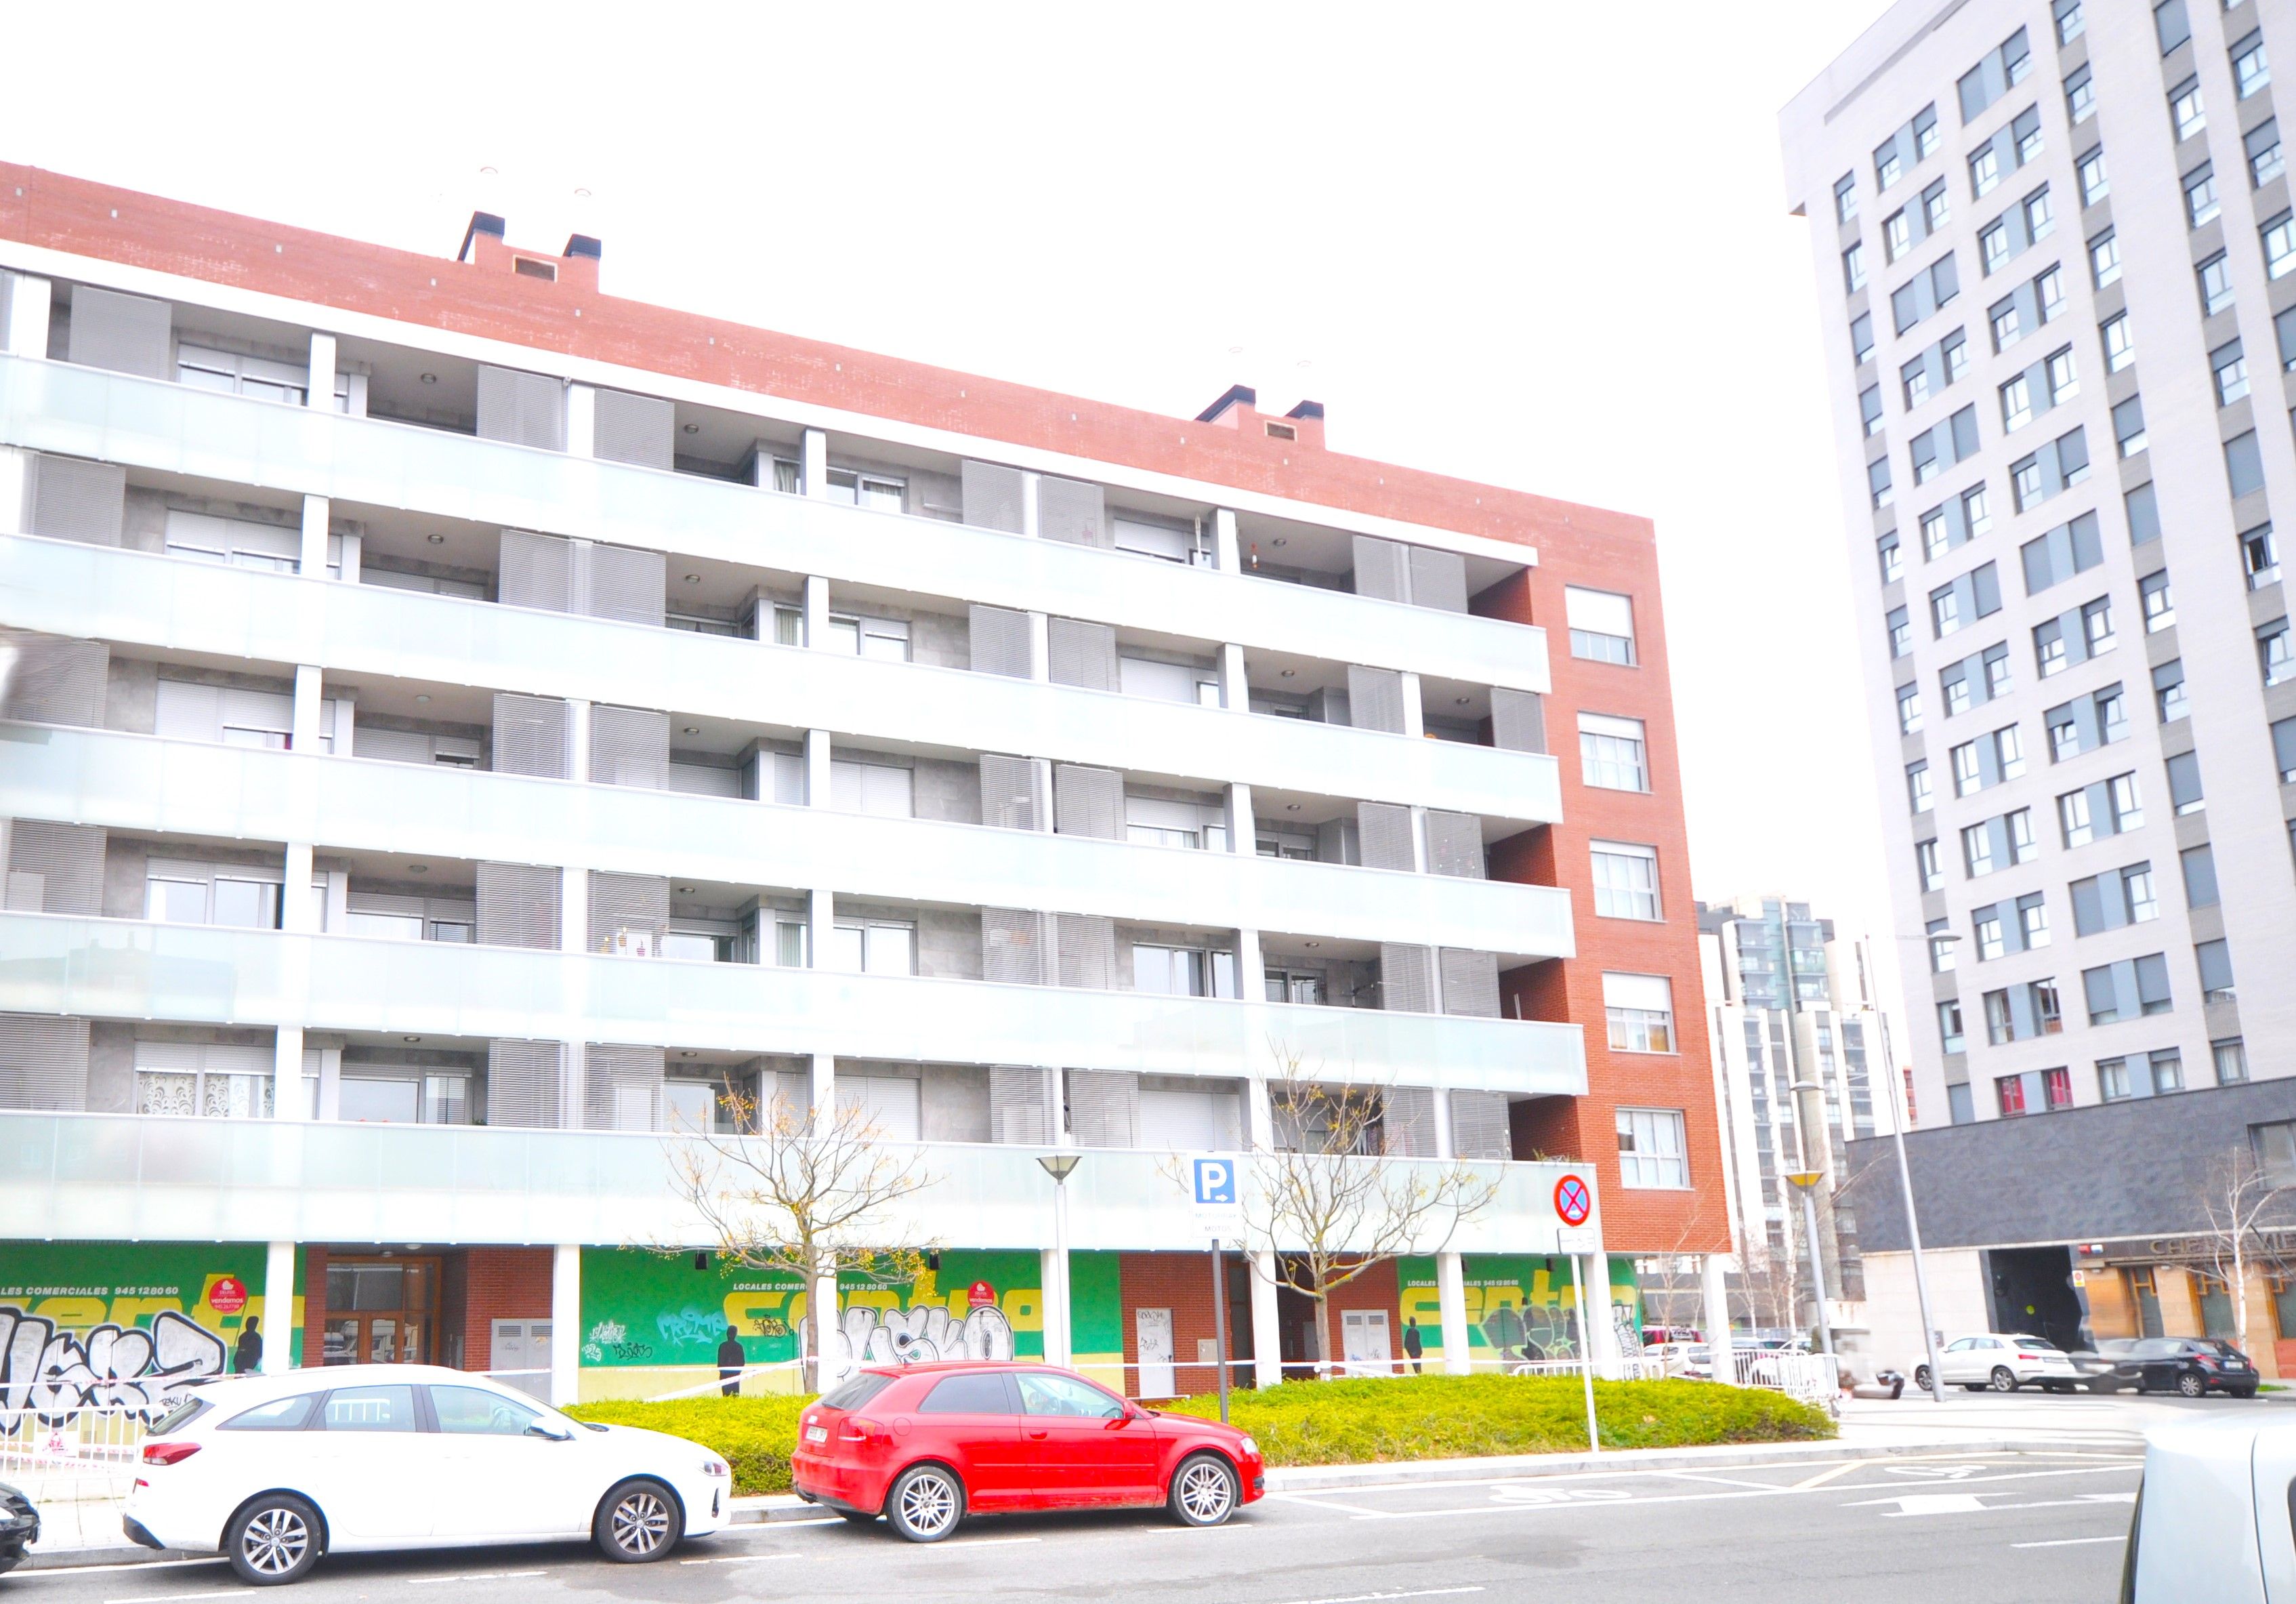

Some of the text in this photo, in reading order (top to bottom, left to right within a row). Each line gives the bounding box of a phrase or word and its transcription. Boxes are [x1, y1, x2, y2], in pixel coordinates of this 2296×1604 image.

[1201, 1162, 1227, 1199] P
[26, 1287, 108, 1295] COMERCIALES
[114, 1287, 135, 1295] 945
